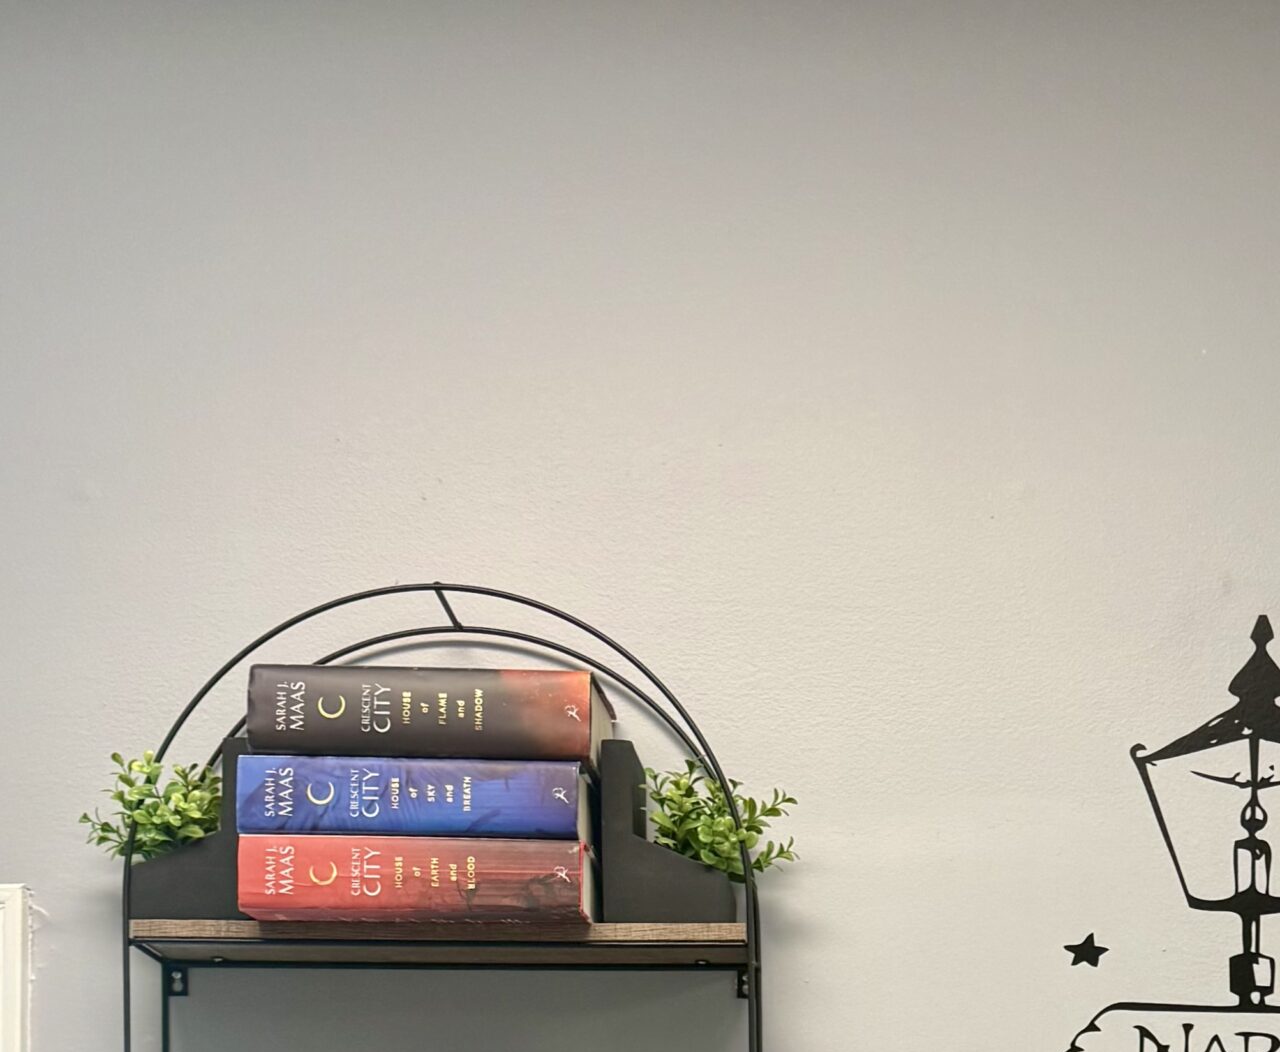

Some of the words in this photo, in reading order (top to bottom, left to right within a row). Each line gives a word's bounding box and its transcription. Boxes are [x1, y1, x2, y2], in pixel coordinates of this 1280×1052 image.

[275, 691, 287, 731] SARAH
[290, 681, 306, 731] MAAS
[361, 684, 371, 732] CRESCENT
[374, 683, 391, 733] CITY
[403, 691, 411, 724] HOUSE
[420, 702, 429, 713] of
[438, 693, 447, 725] FLAME
[456, 700, 465, 718] and
[475, 689, 483, 730] SHADOW
[264, 777, 276, 817] SARAH
[278, 767, 294, 817] MAAS
[350, 769, 360, 817] CRESCENT
[363, 768, 380, 818] CITY
[391, 777, 399, 809] HOUSE
[409, 787, 418, 798] of
[427, 784, 436, 802] SKY
[445, 785, 454, 803] and
[463, 776, 472, 812] BREATH
[265, 845, 277, 853] J.
[264, 856, 276, 895] SARAH
[279, 845, 295, 896] MAAS
[350, 848, 361, 896] CRESCENT
[364, 847, 381, 896] CITY
[395, 856, 403, 888] HOUSE
[412, 866, 421, 877] of
[431, 858, 439, 887] EARTH
[449, 864, 457, 881] and
[466, 856, 475, 890] BLOOD
